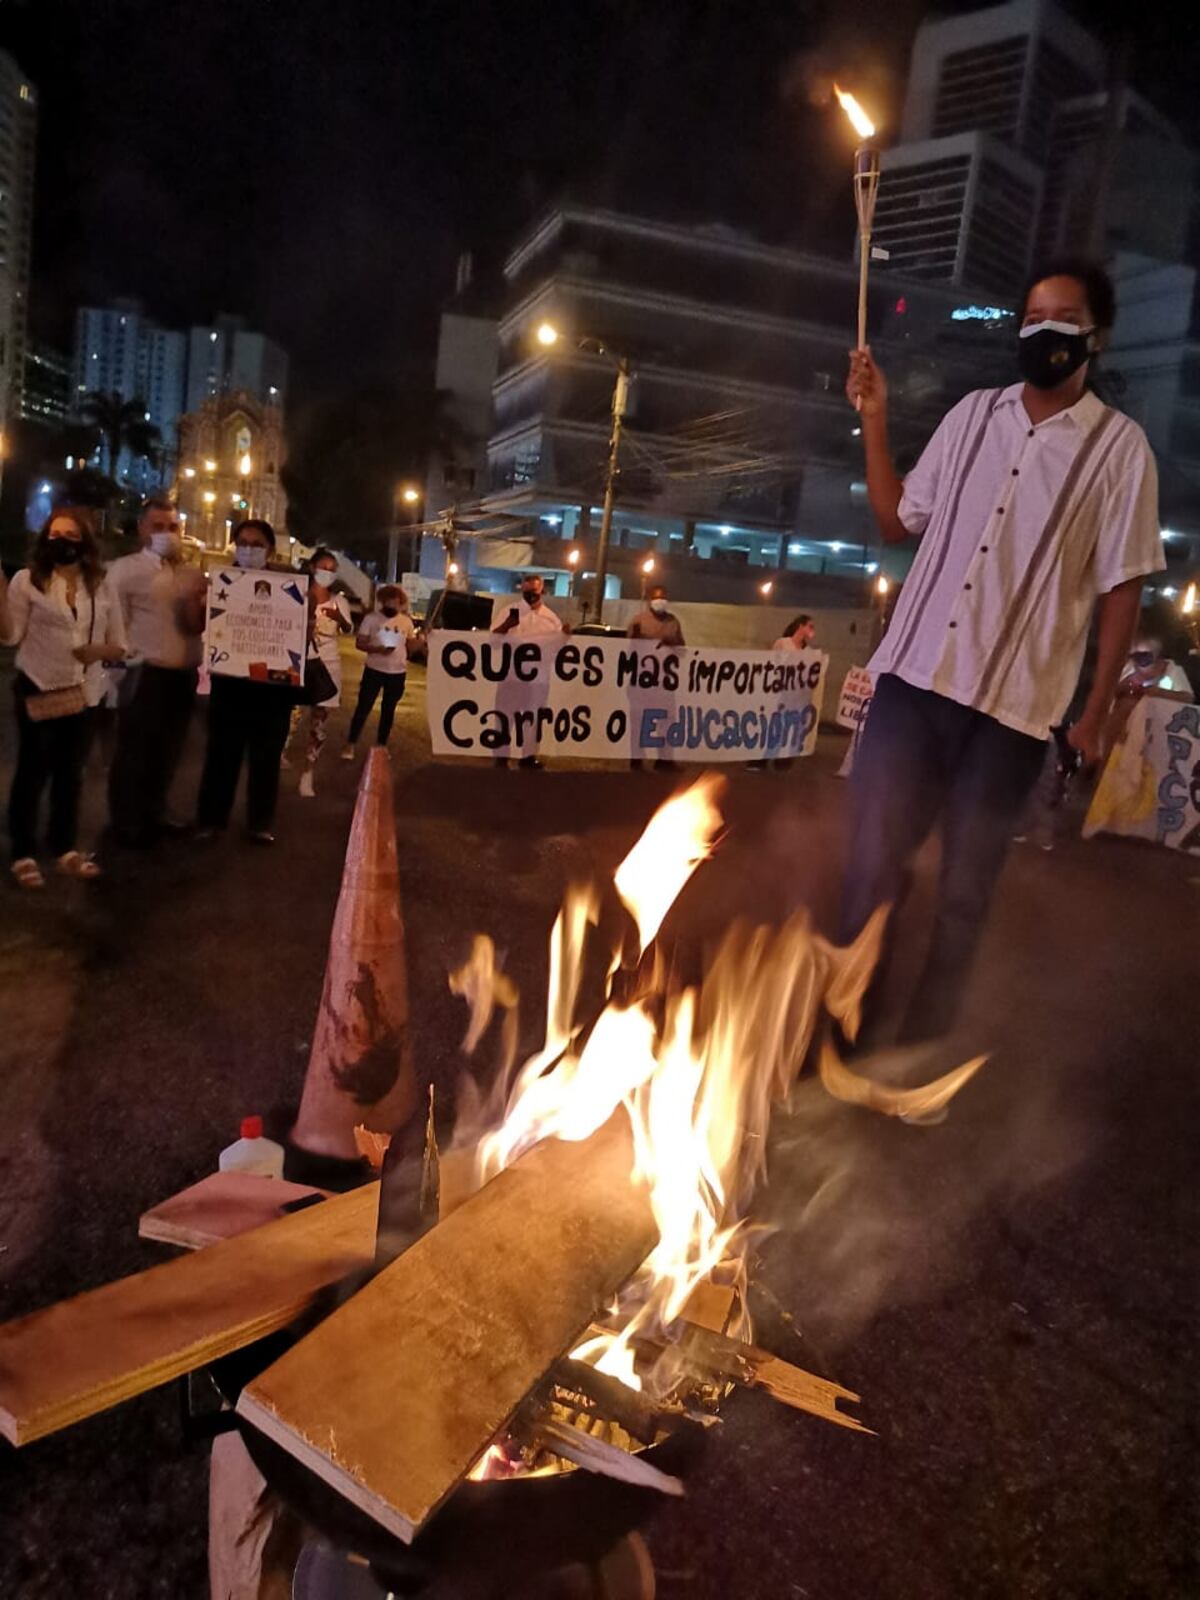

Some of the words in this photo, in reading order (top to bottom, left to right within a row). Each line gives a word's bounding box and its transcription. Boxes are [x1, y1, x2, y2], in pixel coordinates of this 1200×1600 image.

[555, 645, 604, 687] es
[443, 699, 592, 749] Carros
[606, 709, 627, 743] o
